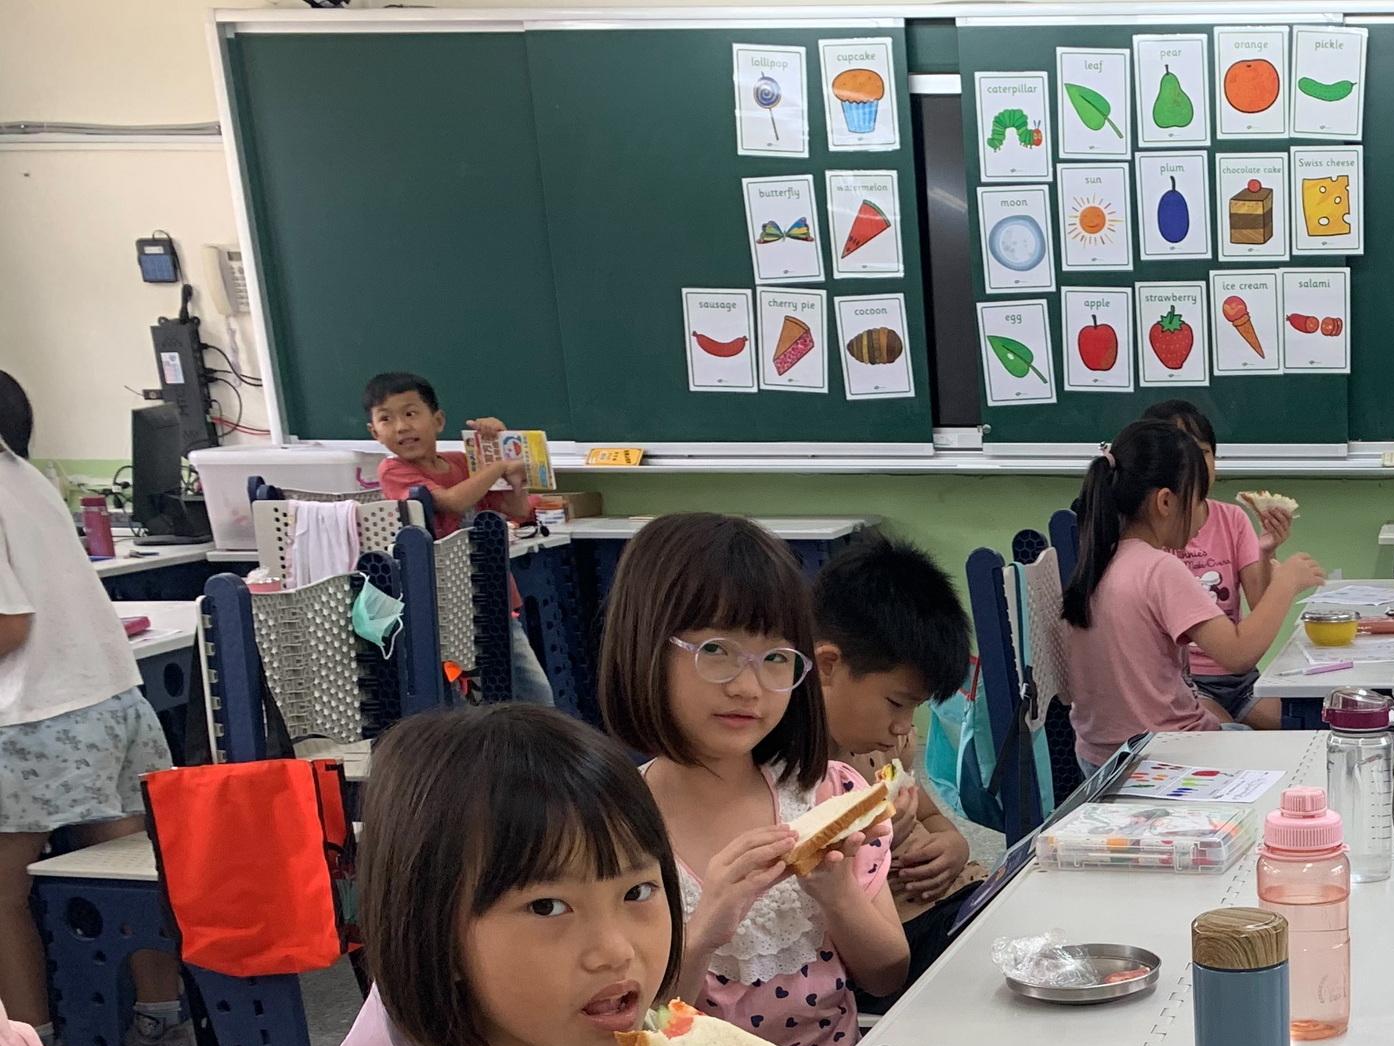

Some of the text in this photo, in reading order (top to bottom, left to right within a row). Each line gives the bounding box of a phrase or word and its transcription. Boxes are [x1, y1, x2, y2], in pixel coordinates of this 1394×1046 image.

[1234, 40, 1269, 51] orange
[1315, 38, 1344, 50] pickle
[836, 52, 876, 64] cupcake
[1160, 48, 1182, 60] pear
[751, 57, 789, 70] lollipop
[1084, 60, 1103, 73] leaf
[987, 84, 1037, 95] caterpillar
[1298, 157, 1355, 168] Swiss cheese
[1160, 163, 1185, 174] plum
[1222, 165, 1282, 175] chocolate cake
[1085, 175, 1102, 185] sun
[758, 188, 800, 199] butterfly
[1000, 198, 1028, 207] moon
[1222, 280, 1269, 291] ice cream
[1298, 278, 1331, 289] salami
[698, 300, 737, 310] sausage
[767, 298, 816, 311] cherry pie
[1084, 298, 1111, 310] apple
[1145, 293, 1197, 306] strawberry
[854, 307, 888, 316] cocoon
[1004, 315, 1023, 325] egg
